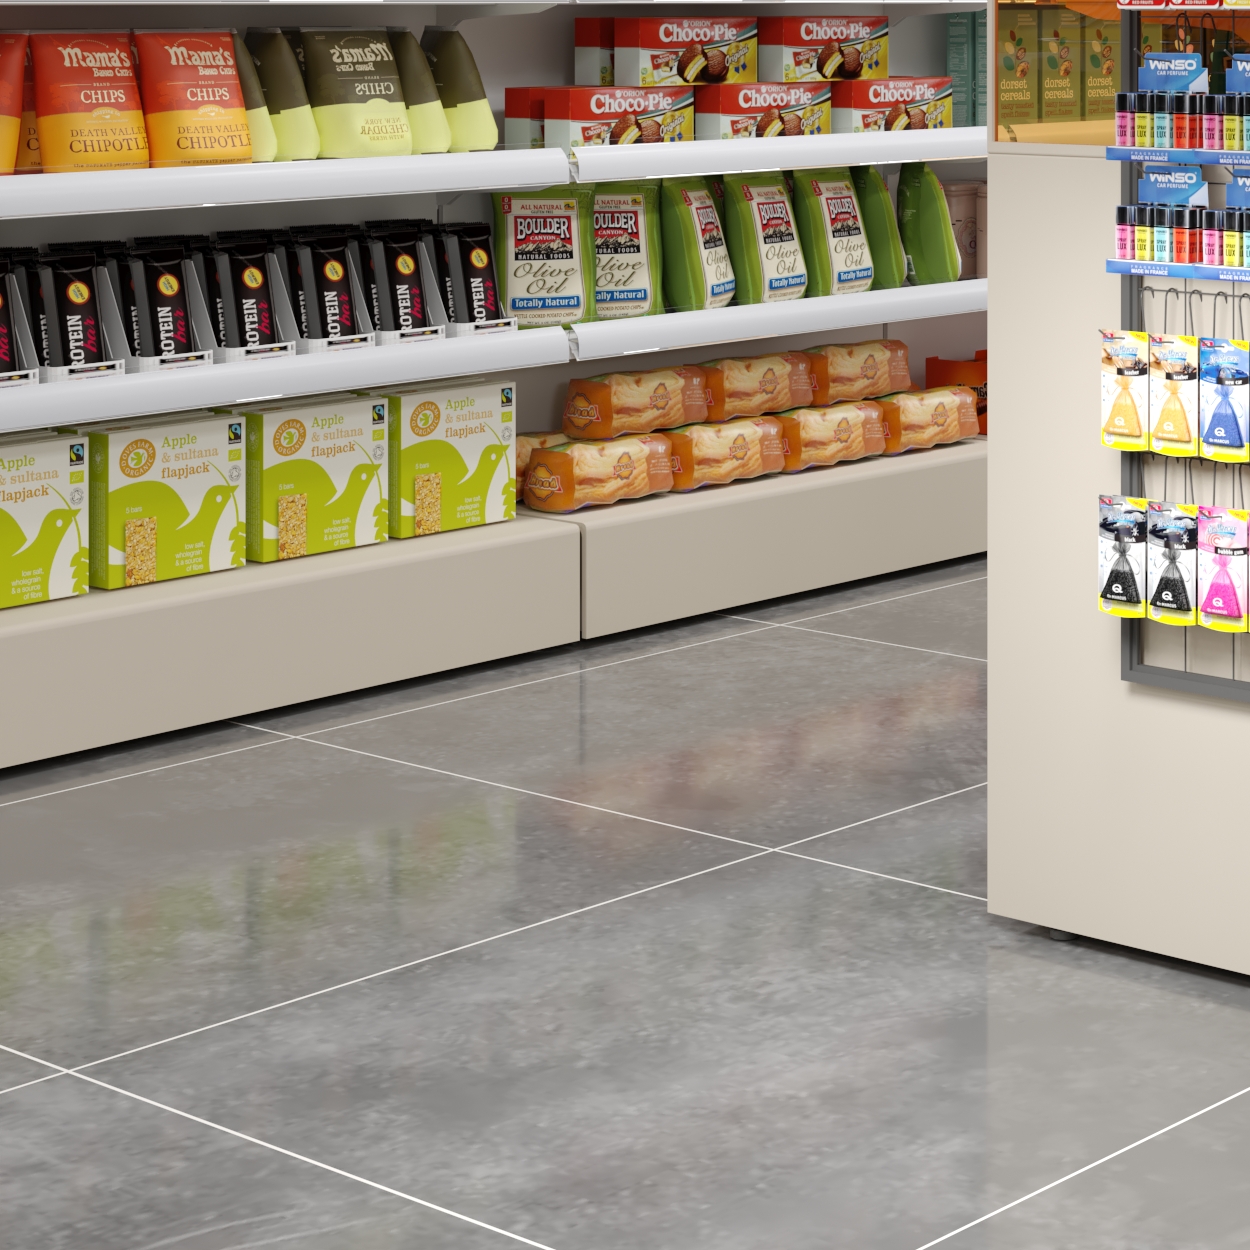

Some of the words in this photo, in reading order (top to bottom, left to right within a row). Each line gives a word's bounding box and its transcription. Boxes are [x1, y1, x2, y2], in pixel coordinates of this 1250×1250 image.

[57, 45, 131, 67] Mama's
[164, 45, 234, 66] Mama's
[80, 89, 126, 103] CHIPS
[187, 87, 230, 101] CHIPS
[801, 108, 823, 129] Original
[925, 104, 945, 124] Original
[70, 128, 108, 138] DEATH
[110, 126, 146, 136] VALLEY
[177, 125, 213, 135] DEATH
[215, 124, 250, 133] VALLEY
[660, 115, 685, 137] Original
[759, 204, 790, 226] BOULDER
[516, 218, 570, 240] BOULDER
[765, 245, 799, 261] Olive
[513, 262, 578, 279] Olive
[776, 259, 797, 275] Oil
[526, 277, 567, 294] Oil
[771, 278, 788, 289] Totally
[788, 276, 805, 286] Natural
[514, 298, 543, 308] Totally
[545, 297, 577, 306] Natural
[614, 290, 645, 299] Natural
[444, 397, 475, 412] Apple
[311, 414, 344, 429] Apple
[322, 426, 364, 442] sultana
[444, 423, 486, 439] flapjack
[162, 434, 197, 449] Apple
[162, 452, 171, 463] &
[174, 448, 219, 461] sultana
[311, 442, 356, 459] flapjack
[161, 462, 210, 479] flapjack
[175, 550, 202, 559] wholegrain
